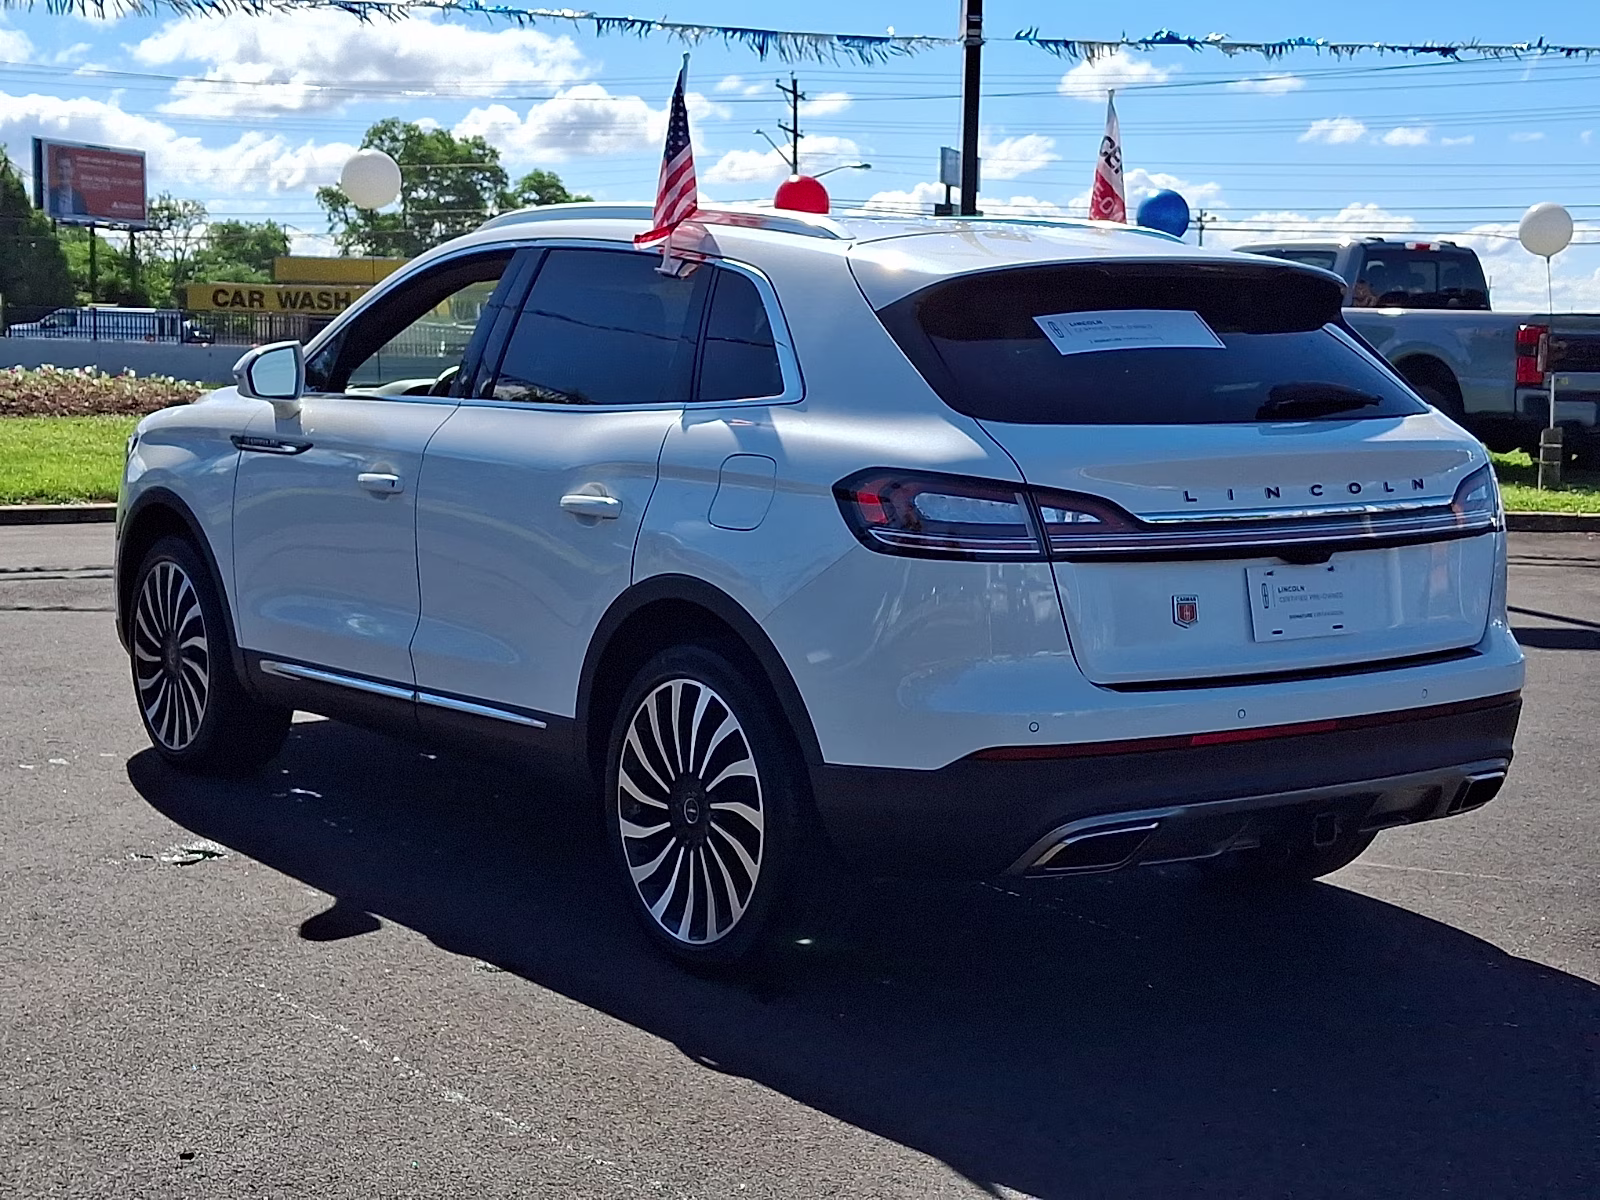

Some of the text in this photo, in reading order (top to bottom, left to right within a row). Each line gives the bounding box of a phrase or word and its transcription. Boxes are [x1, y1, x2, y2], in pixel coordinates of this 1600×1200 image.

[212, 288, 351, 310] CAR WASH
[1184, 478, 1424, 503] LINCOLN
[1277, 585, 1305, 594] LINCOLN
